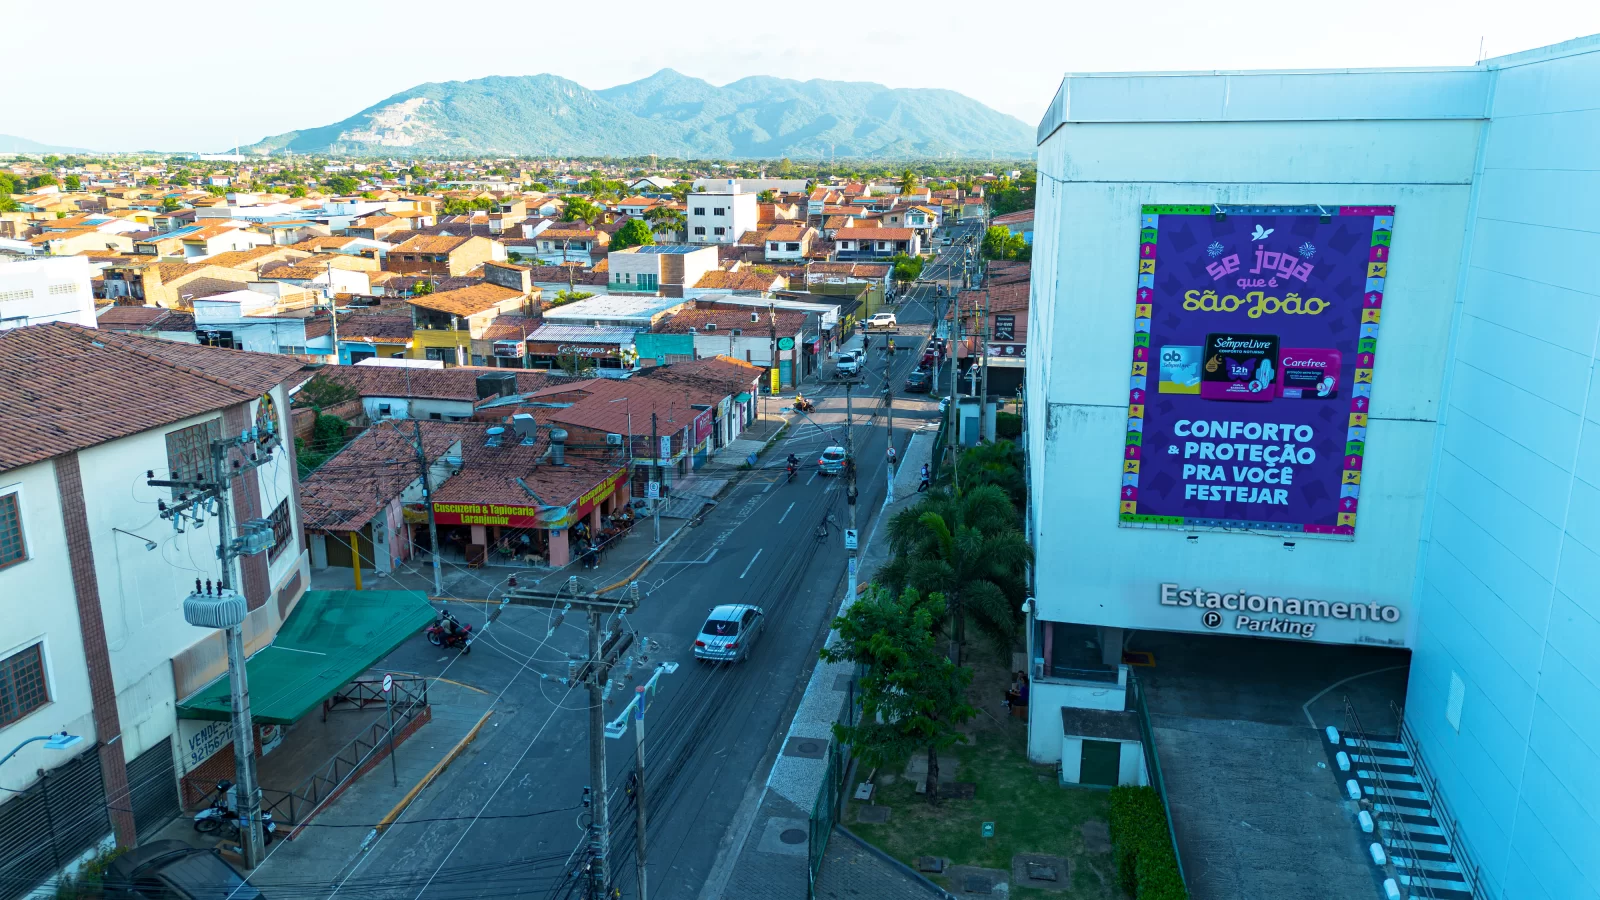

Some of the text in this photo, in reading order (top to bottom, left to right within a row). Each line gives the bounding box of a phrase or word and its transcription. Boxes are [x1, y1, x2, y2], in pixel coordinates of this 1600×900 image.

[1205, 245, 1314, 283] se joga
[1236, 277, 1278, 289] que é
[1183, 289, 1330, 319] São João
[1283, 357, 1326, 368] Carefree
[1174, 419, 1314, 443] CONFORTO
[1167, 441, 1316, 467] & PROTEÇÃO
[1182, 463, 1293, 485] PRA VOCÊ
[1184, 484, 1288, 505] FESTEJAR
[433, 503, 535, 517] Cuscuzeria & Tapiocaria
[460, 513, 509, 525] Laranjunior
[1160, 583, 1401, 624] Estacionamento
[1236, 615, 1317, 638] Parking
